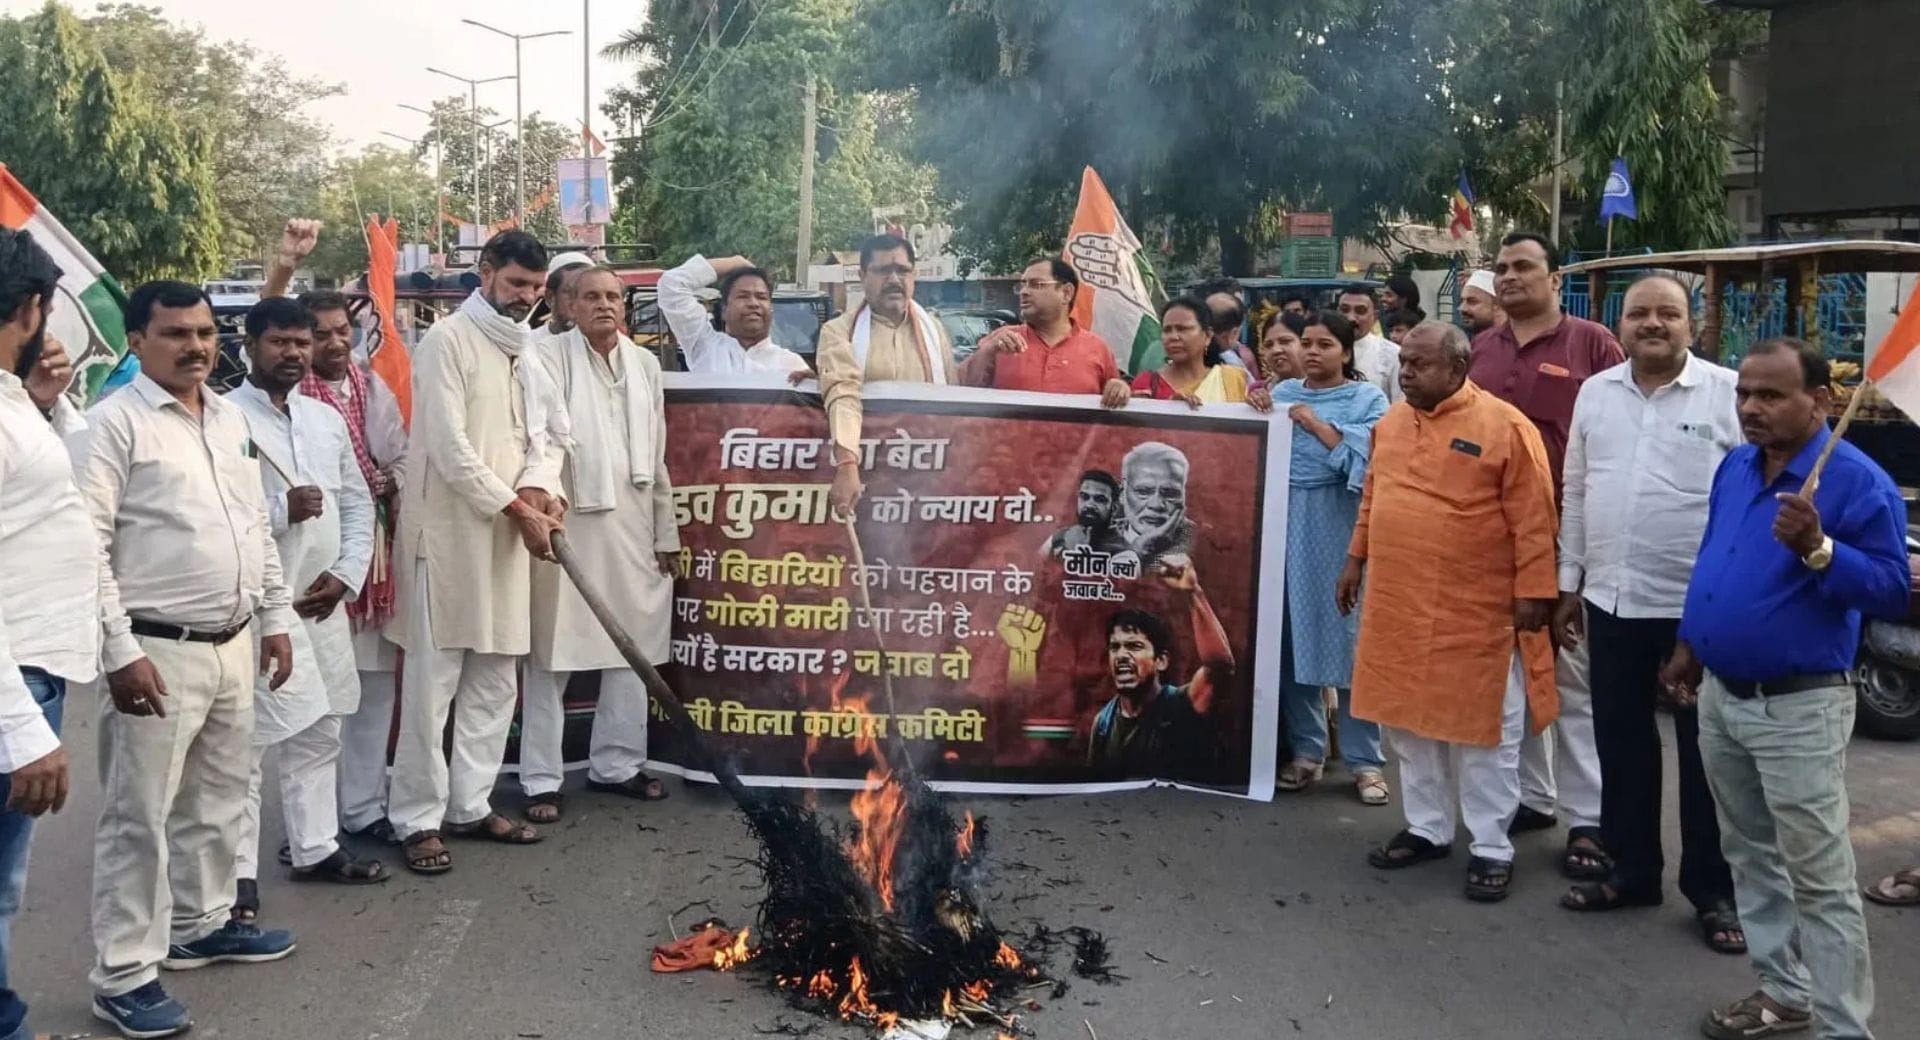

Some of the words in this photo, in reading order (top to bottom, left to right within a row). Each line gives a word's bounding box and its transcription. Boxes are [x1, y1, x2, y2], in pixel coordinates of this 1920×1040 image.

[720, 427, 823, 470] बिहार
[885, 428, 950, 470] बेटा
[671, 484, 720, 527] डव
[871, 488, 915, 524] को
[918, 495, 999, 523] न्याय
[695, 549, 717, 582] में
[720, 549, 846, 587] बिहारियों
[849, 557, 892, 590] को
[897, 566, 996, 595] पहचान
[1001, 563, 1034, 595] के
[1064, 545, 1110, 575] मौन
[1111, 560, 1138, 577] क्यों
[1064, 582, 1098, 598] जवाब
[676, 597, 702, 623] पर
[705, 593, 779, 627] गोली
[783, 597, 851, 631] मारी
[899, 602, 947, 637] रही
[702, 632, 719, 672] है
[722, 644, 826, 675] सरकार
[940, 645, 972, 681] दो
[719, 700, 797, 736] जिला
[896, 707, 986, 742] कमिटी
